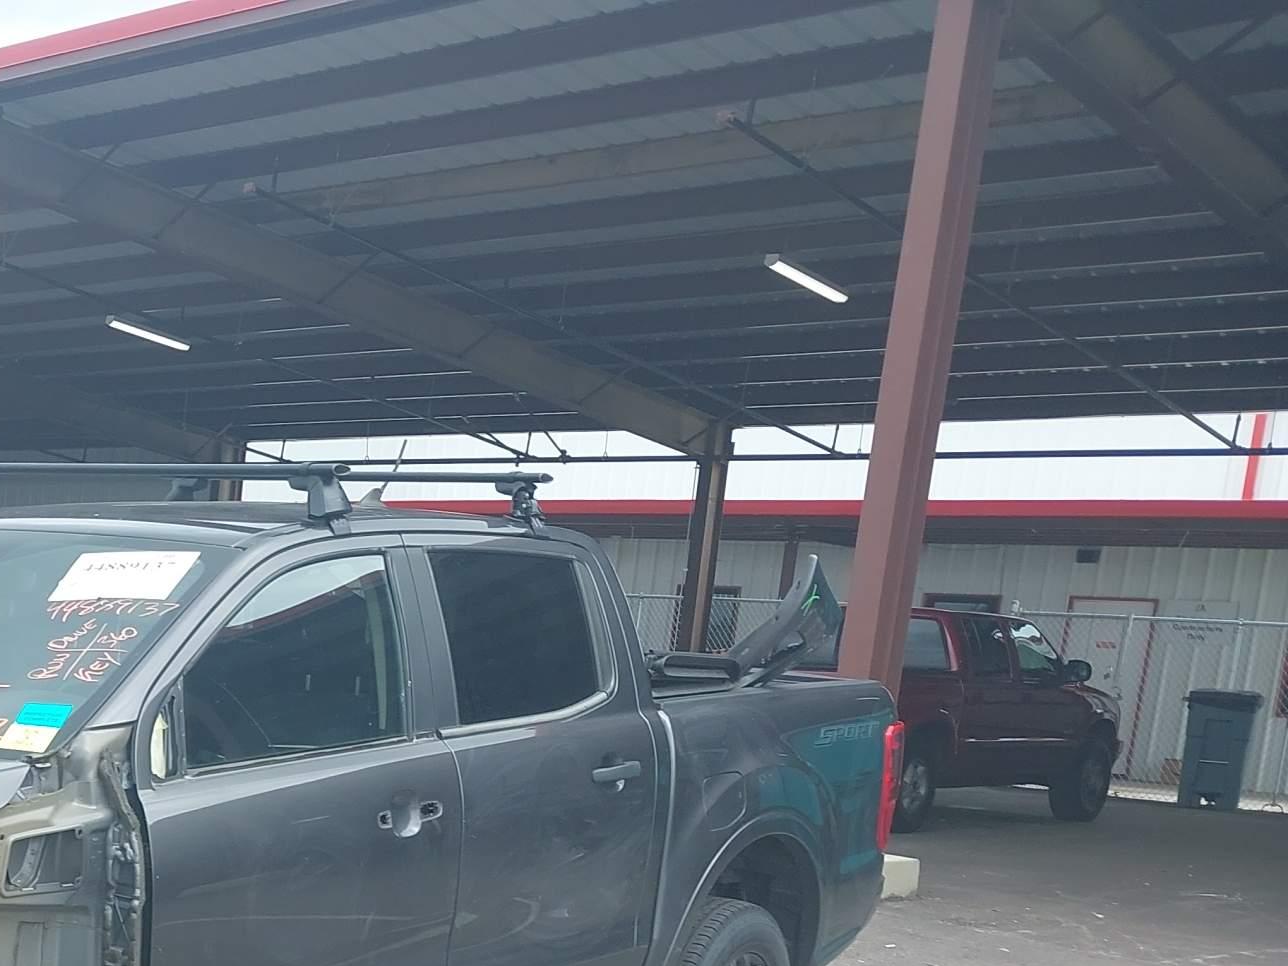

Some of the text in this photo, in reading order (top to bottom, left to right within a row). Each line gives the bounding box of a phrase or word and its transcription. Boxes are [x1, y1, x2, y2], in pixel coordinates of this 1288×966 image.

[97, 626, 138, 650] 360
[26, 653, 70, 681] RUN
[74, 652, 122, 683] KEY
[814, 720, 880, 748] SPORT
